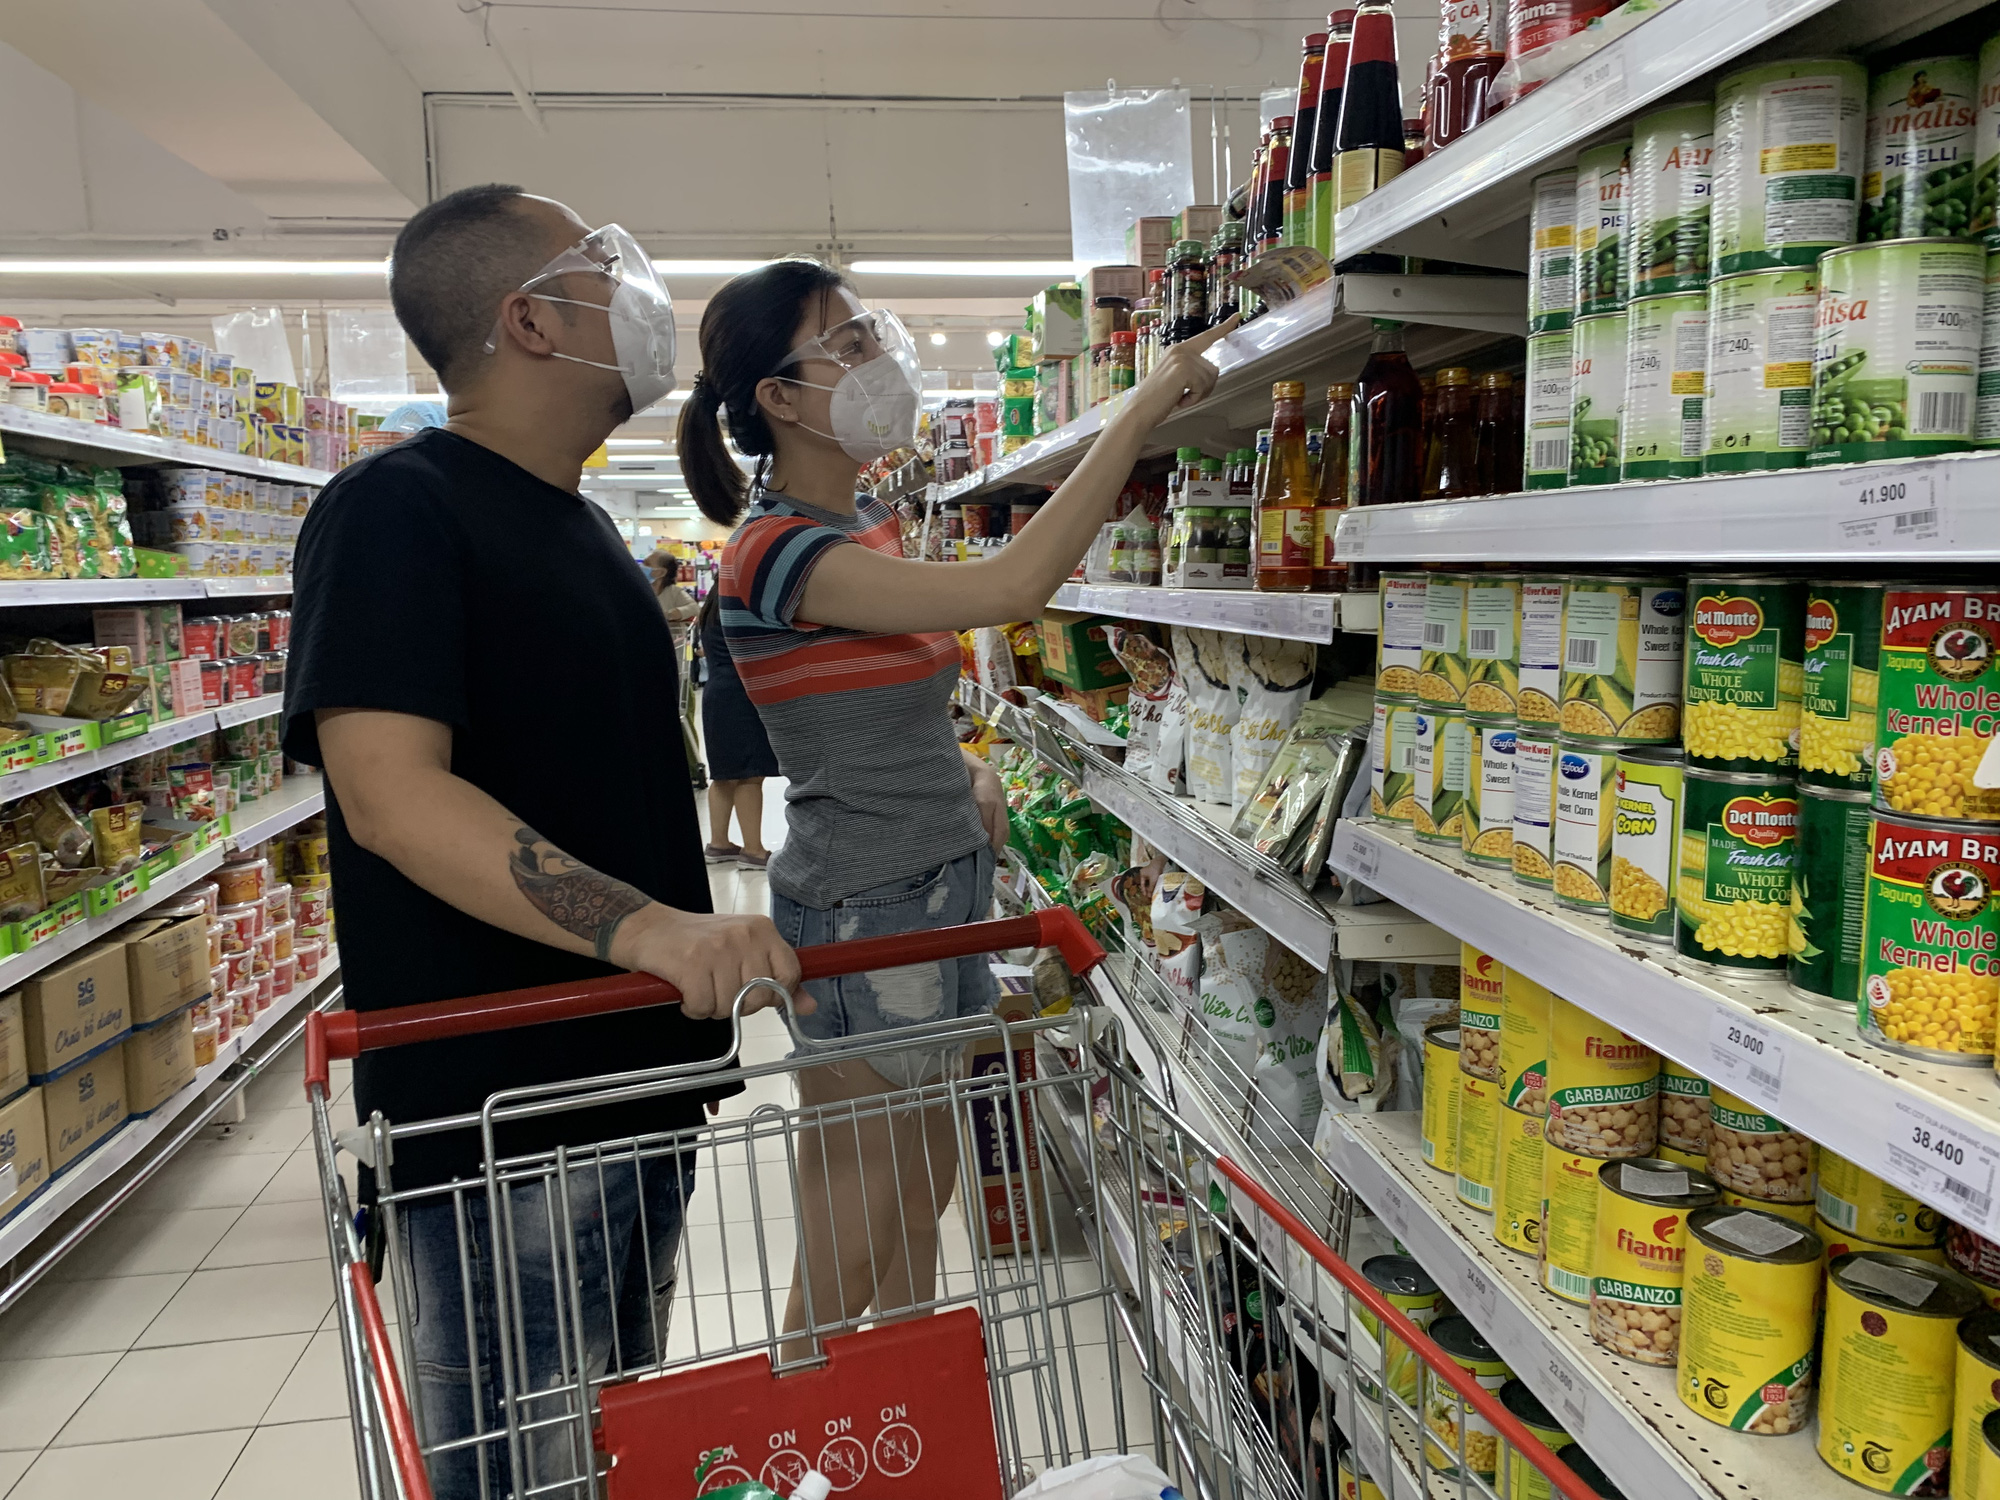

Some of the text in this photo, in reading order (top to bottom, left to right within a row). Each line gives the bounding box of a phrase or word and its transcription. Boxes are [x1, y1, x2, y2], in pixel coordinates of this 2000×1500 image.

[1460, 2, 1480, 19] CÀ
[258, 385, 276, 396] VIP
[1859, 483, 1906, 505] 41.900
[1697, 611, 1758, 626] Del Monte
[1886, 600, 1952, 635] AYAM
[1642, 624, 1669, 635] Whole
[1708, 628, 1735, 639] Quality
[1645, 641, 1669, 652] Sweet
[1748, 644, 1773, 653] WITH
[1824, 650, 1846, 660] WITH
[1886, 653, 1926, 673] Jagung
[105, 679, 124, 690] SG
[1701, 673, 1742, 688] WHOLE
[1689, 685, 1764, 703] KERNEL CORN
[1915, 683, 2000, 712] Whole
[1808, 697, 1837, 712] CORN
[1887, 709, 1961, 738] Kernel
[1483, 759, 1508, 770] Whole
[1486, 774, 1510, 784] Sweet
[1572, 788, 1598, 801] Kernel
[1574, 804, 1593, 817] Corn
[1619, 797, 1656, 816] KERNEL
[1616, 812, 1656, 837] CORN
[1729, 809, 1752, 825] Del
[1749, 828, 1779, 840] Quality
[1711, 838, 1738, 850] MADE
[1878, 837, 1949, 865] AYAM
[1570, 852, 1592, 862] Thailand
[1738, 871, 1785, 887] WHOLE
[1715, 883, 1765, 902] KERNEL
[1878, 883, 1922, 908] Jagung
[1911, 918, 1997, 951] Whole
[1880, 937, 1957, 974] Kernel
[78, 977, 95, 999] SG
[1201, 993, 1234, 1019] Viên
[1214, 1028, 1247, 1043] Chicken Balls
[1728, 1026, 1764, 1055] 29.000
[78, 1072, 95, 1094] SG
[1565, 1085, 1640, 1104] GARBANZO
[1720, 1109, 1767, 1131] BEANS
[0, 1128, 16, 1150] SG
[1912, 1127, 1964, 1166] 38.400
[1013, 1187, 1026, 1235] VIFON
[1599, 1278, 1676, 1304] GARBANZO
[1766, 1393, 1784, 1401] 1924
